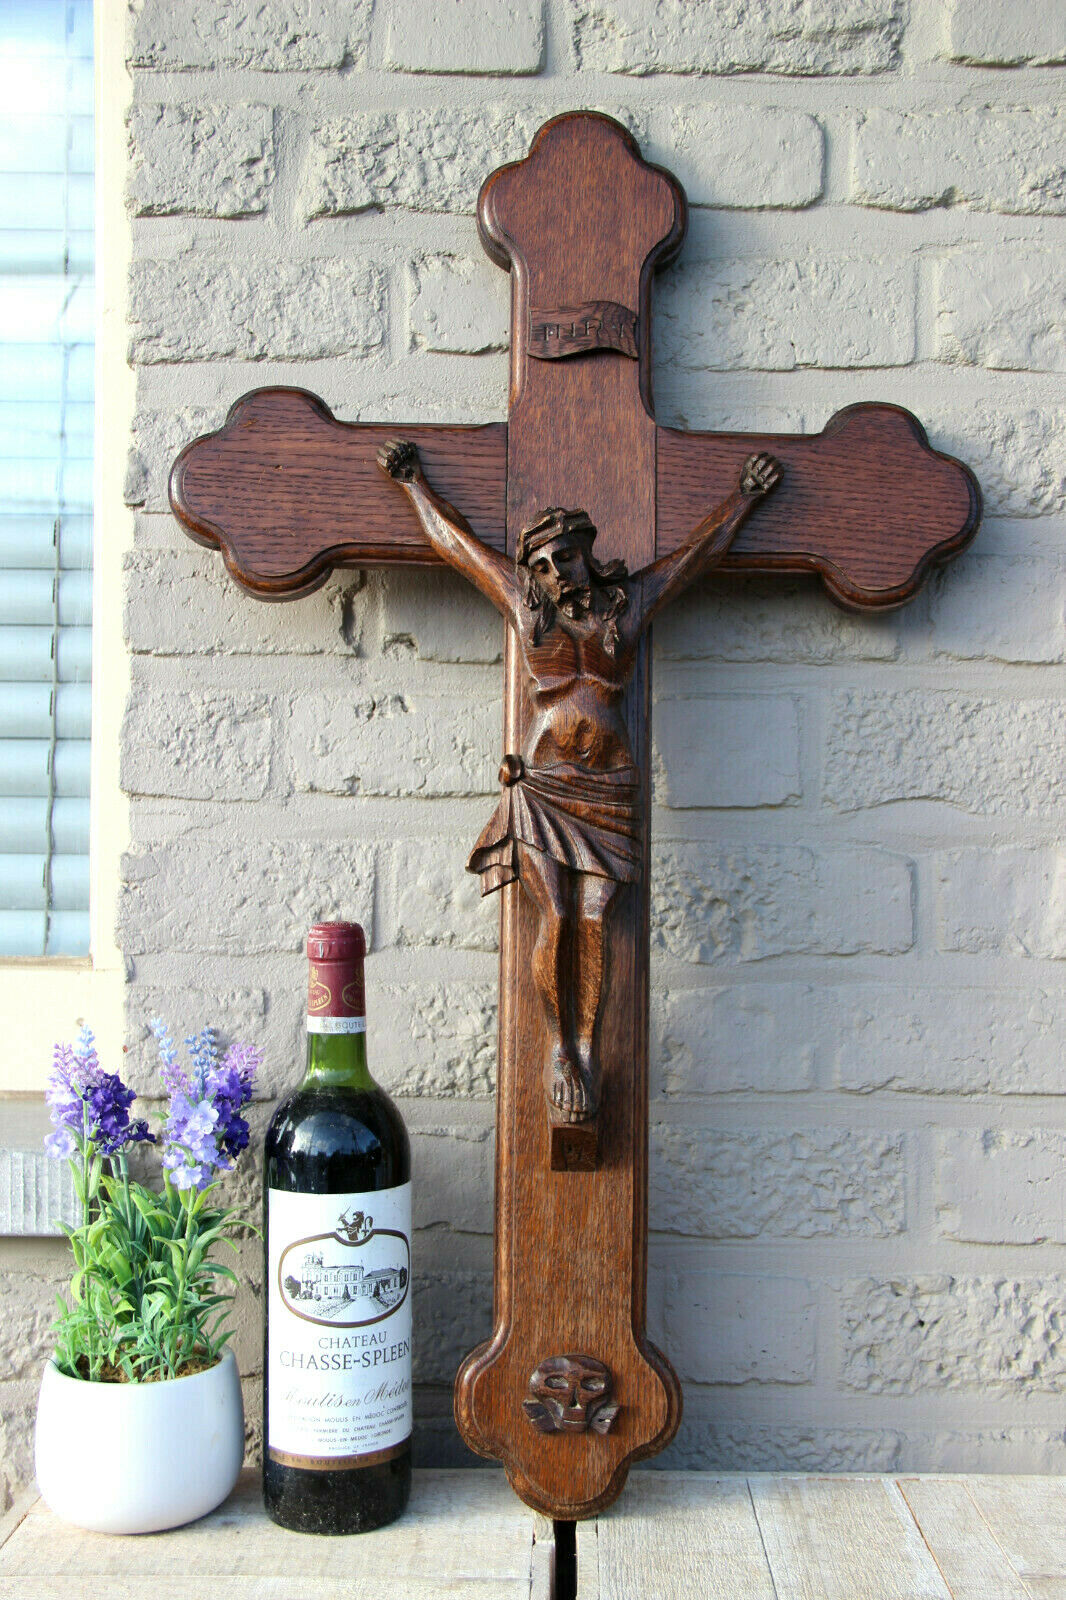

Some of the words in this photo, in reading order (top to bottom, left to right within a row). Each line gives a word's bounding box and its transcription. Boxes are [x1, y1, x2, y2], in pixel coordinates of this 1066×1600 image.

[318, 1331, 387, 1350] CHATEAU
[279, 1337, 410, 1371] CHASSE-SPLEEN
[344, 1397, 362, 1408] en
